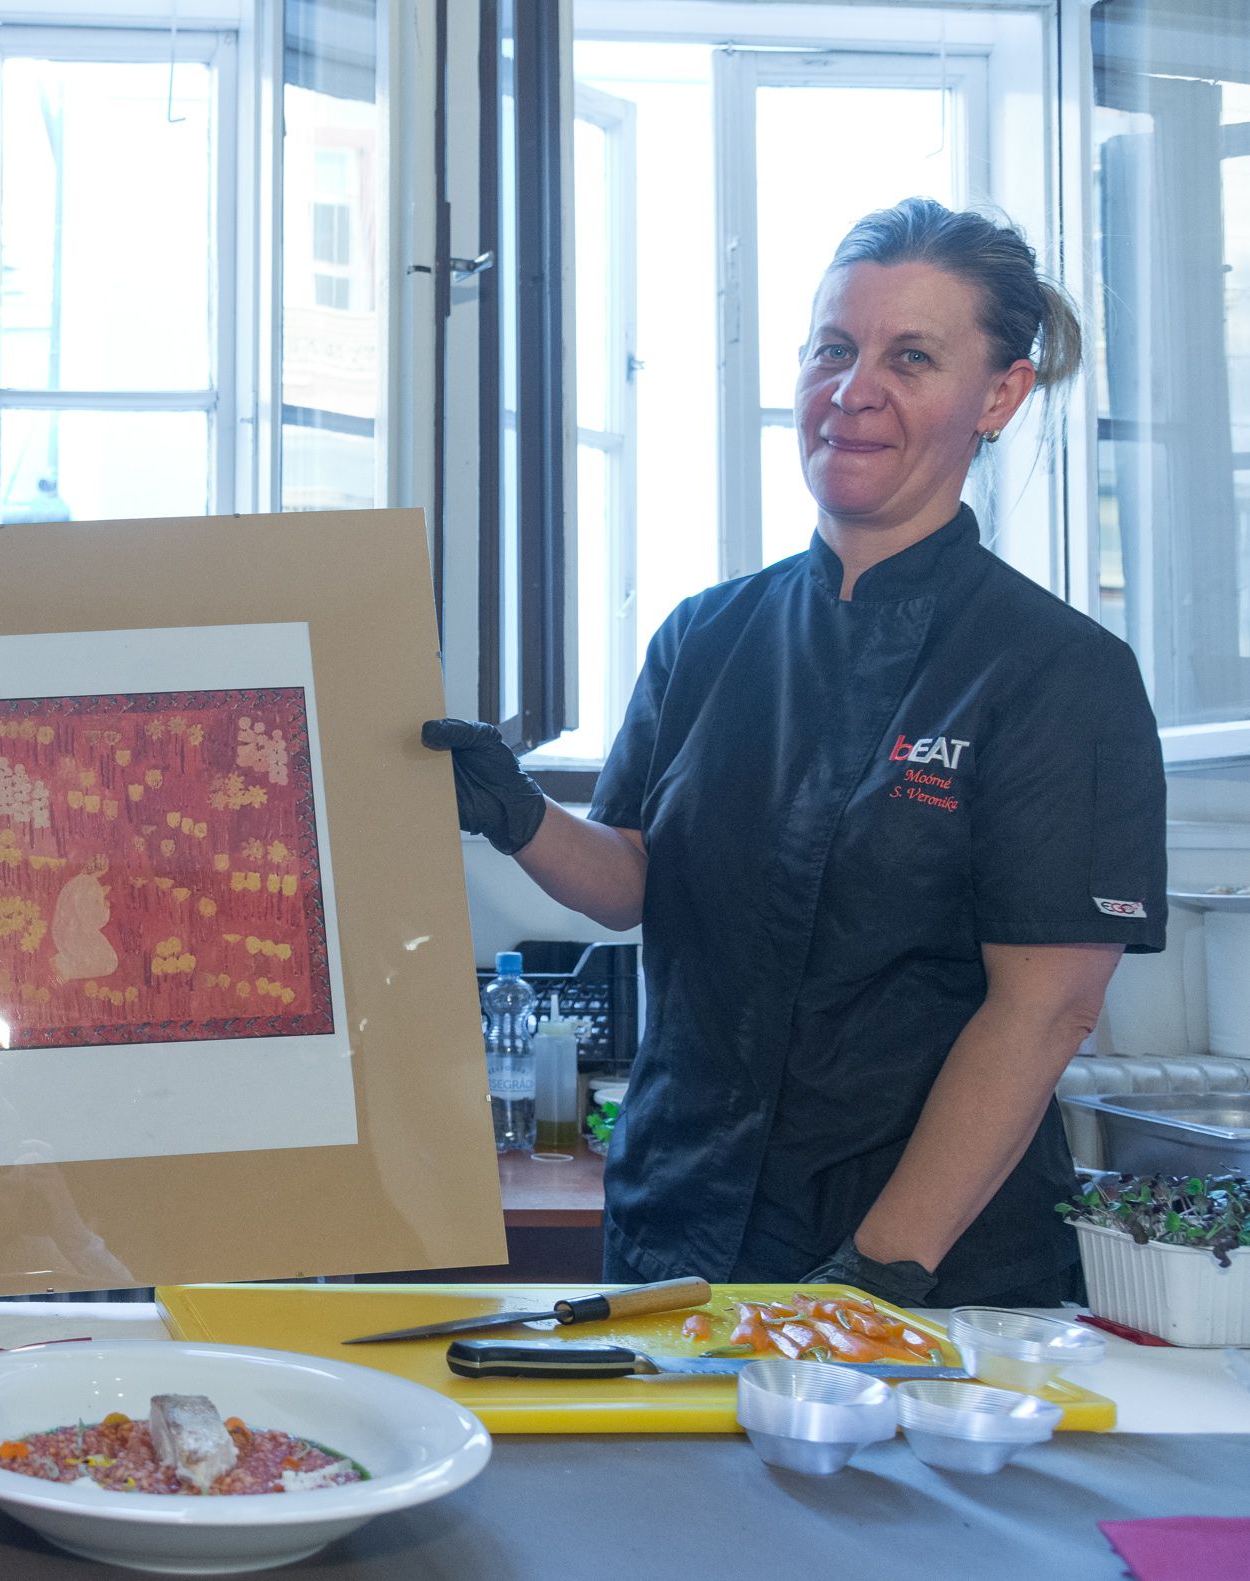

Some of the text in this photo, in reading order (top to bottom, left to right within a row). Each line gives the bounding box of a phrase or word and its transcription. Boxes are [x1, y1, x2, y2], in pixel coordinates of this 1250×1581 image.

[888, 735, 970, 770] bEAT
[889, 786, 959, 812] S. Veronika
